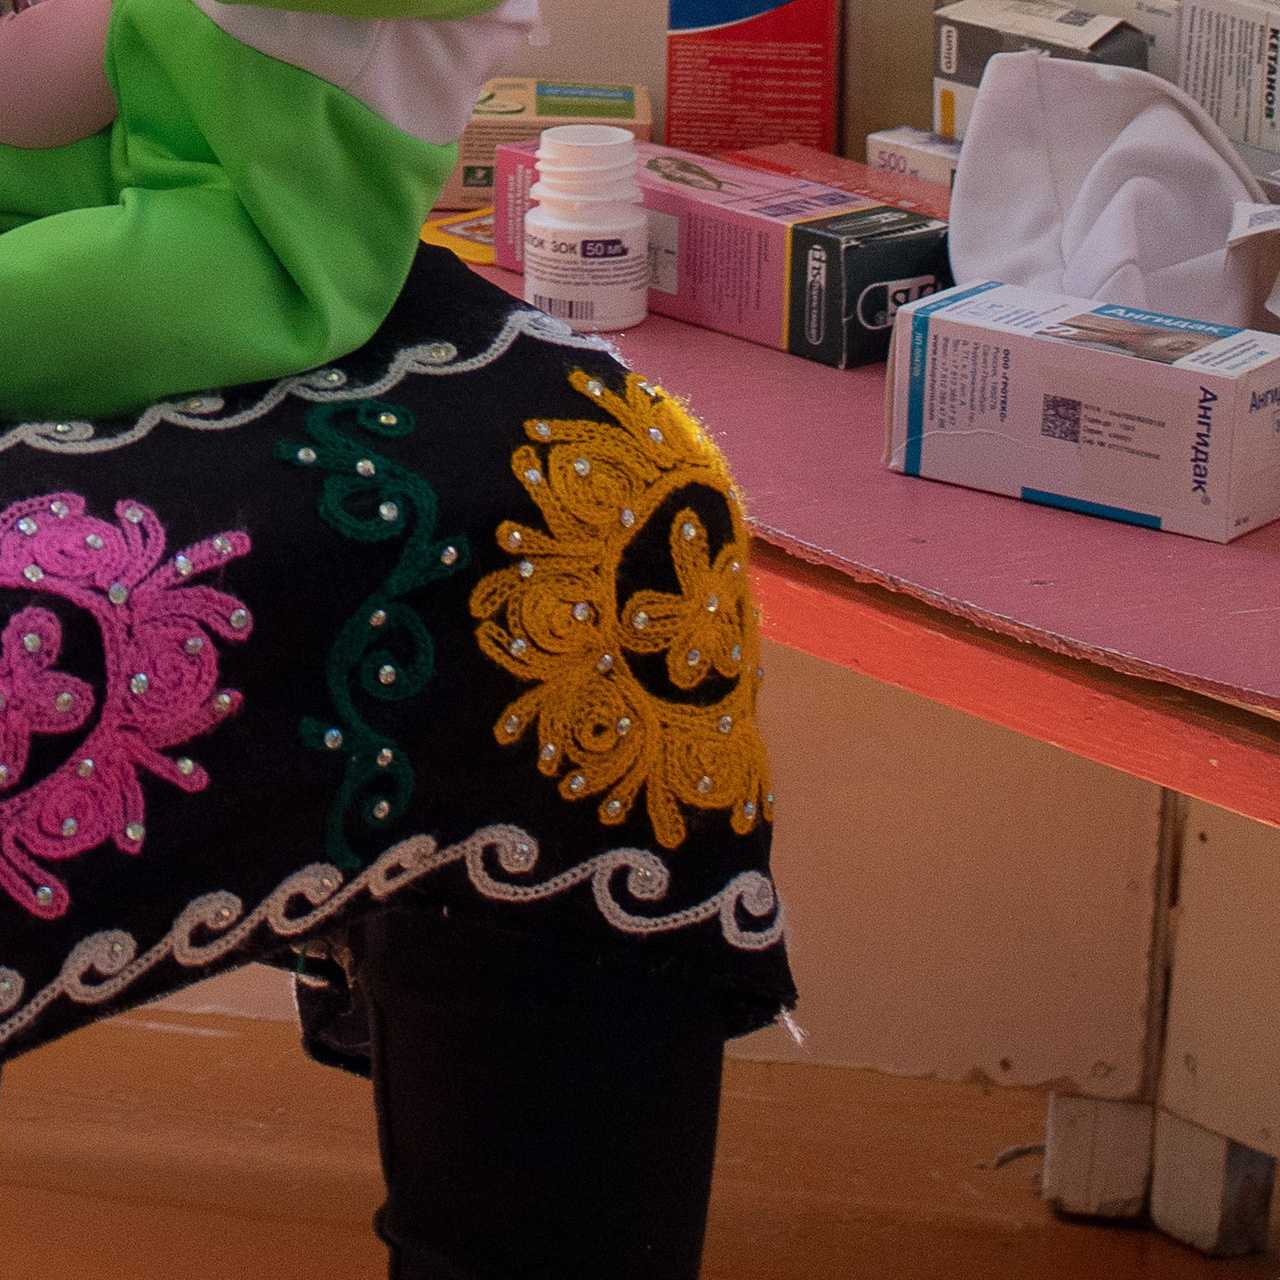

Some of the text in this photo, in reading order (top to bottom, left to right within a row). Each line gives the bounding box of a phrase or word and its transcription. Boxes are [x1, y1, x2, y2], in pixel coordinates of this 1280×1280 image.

[877, 150, 907, 174] 500
[586, 242, 602, 256] 50
[1106, 305, 1220, 334] Ангидак
